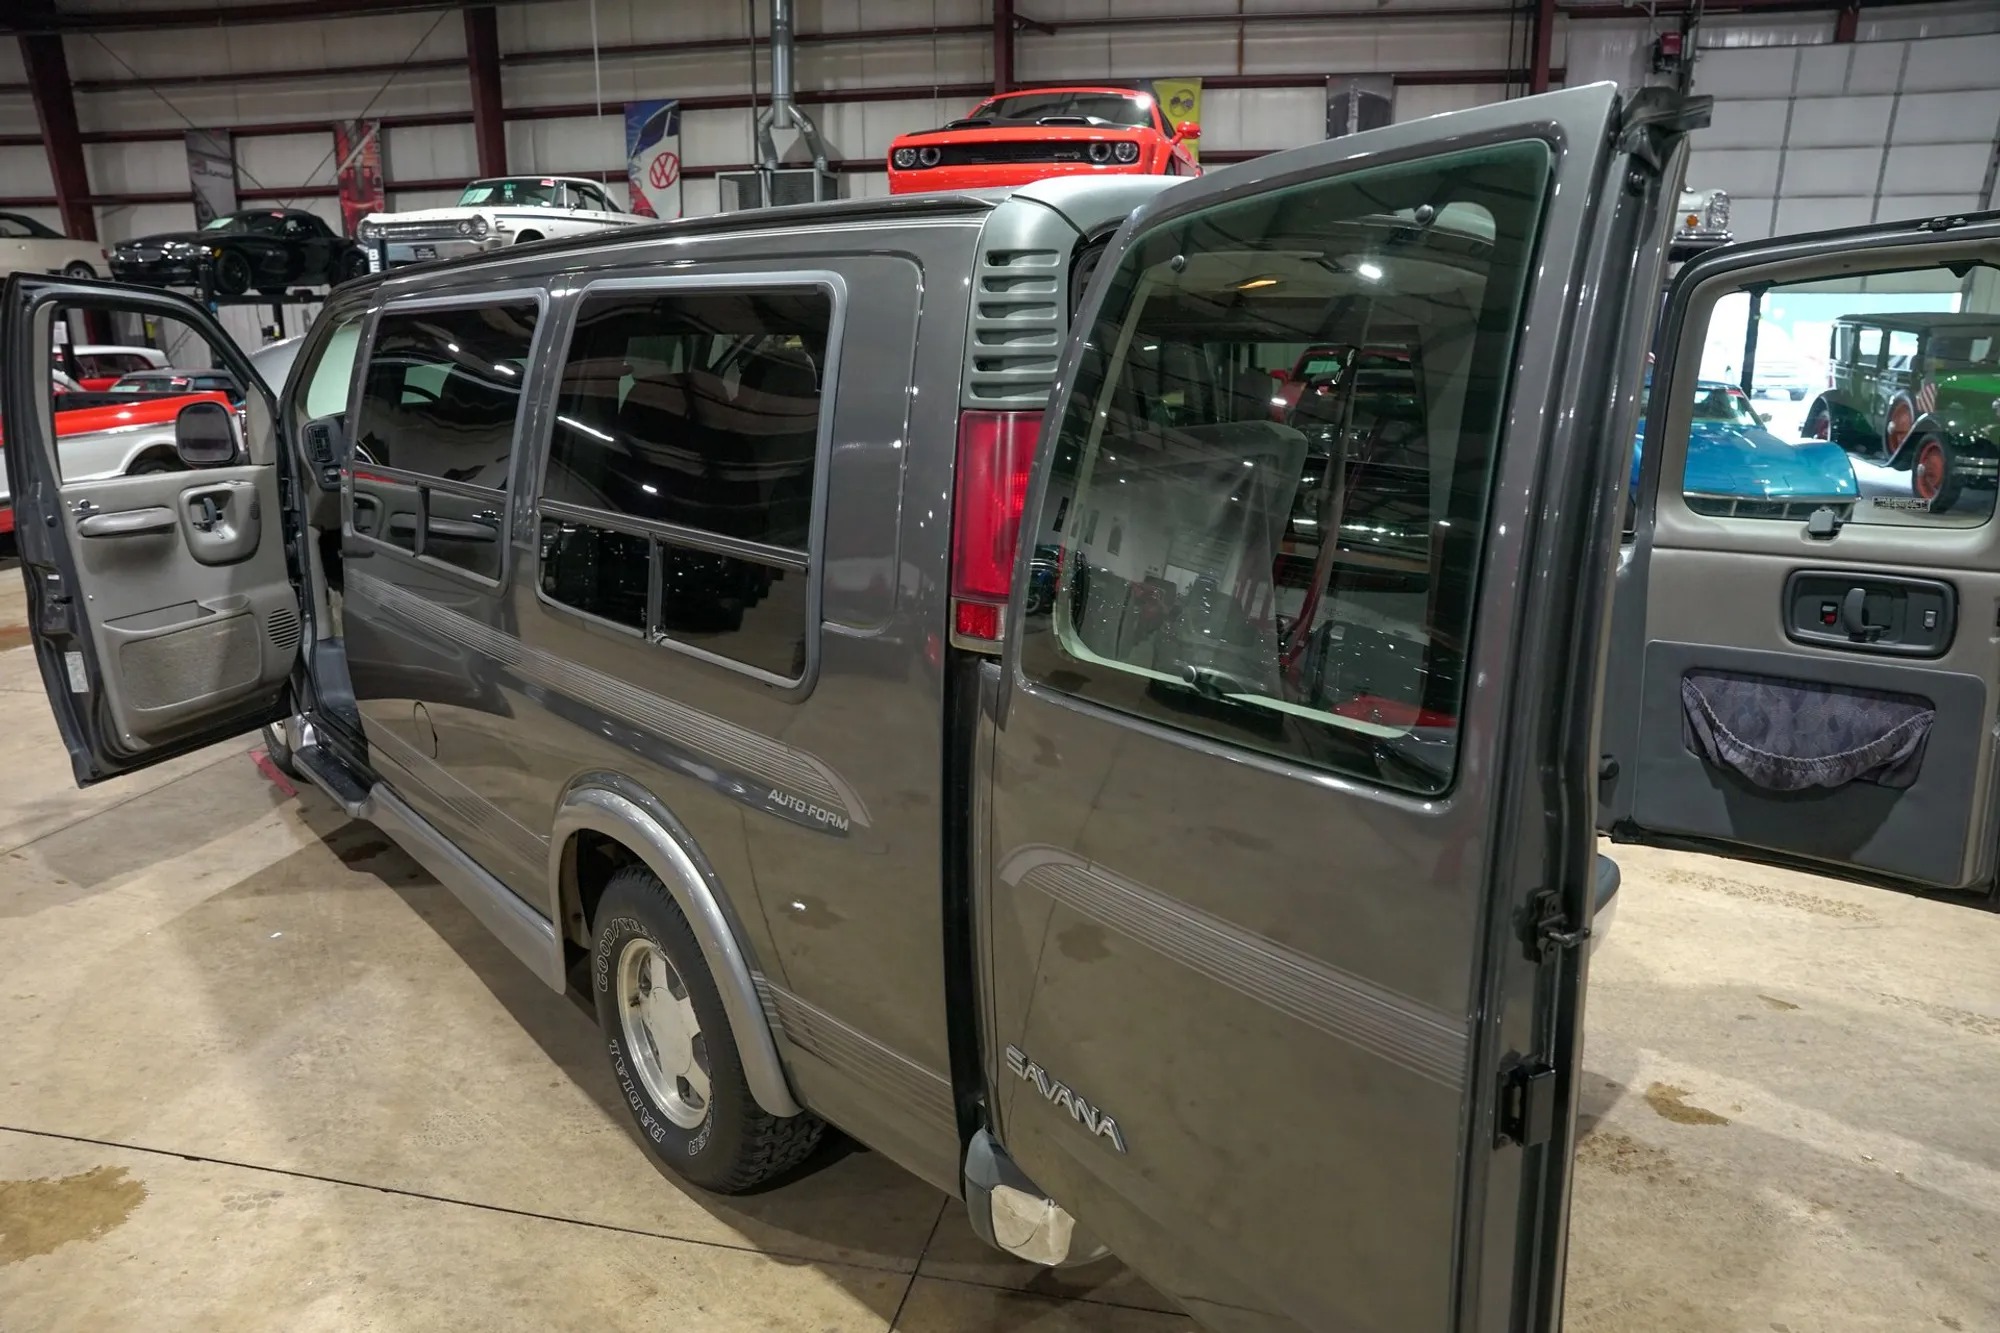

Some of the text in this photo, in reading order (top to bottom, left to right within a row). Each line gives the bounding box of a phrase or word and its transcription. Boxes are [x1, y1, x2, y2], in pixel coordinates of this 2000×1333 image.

[768, 788, 849, 831] AUTO FORM
[609, 1039, 666, 1143] RADIAL
[1006, 1043, 1127, 1155] SAVANA
